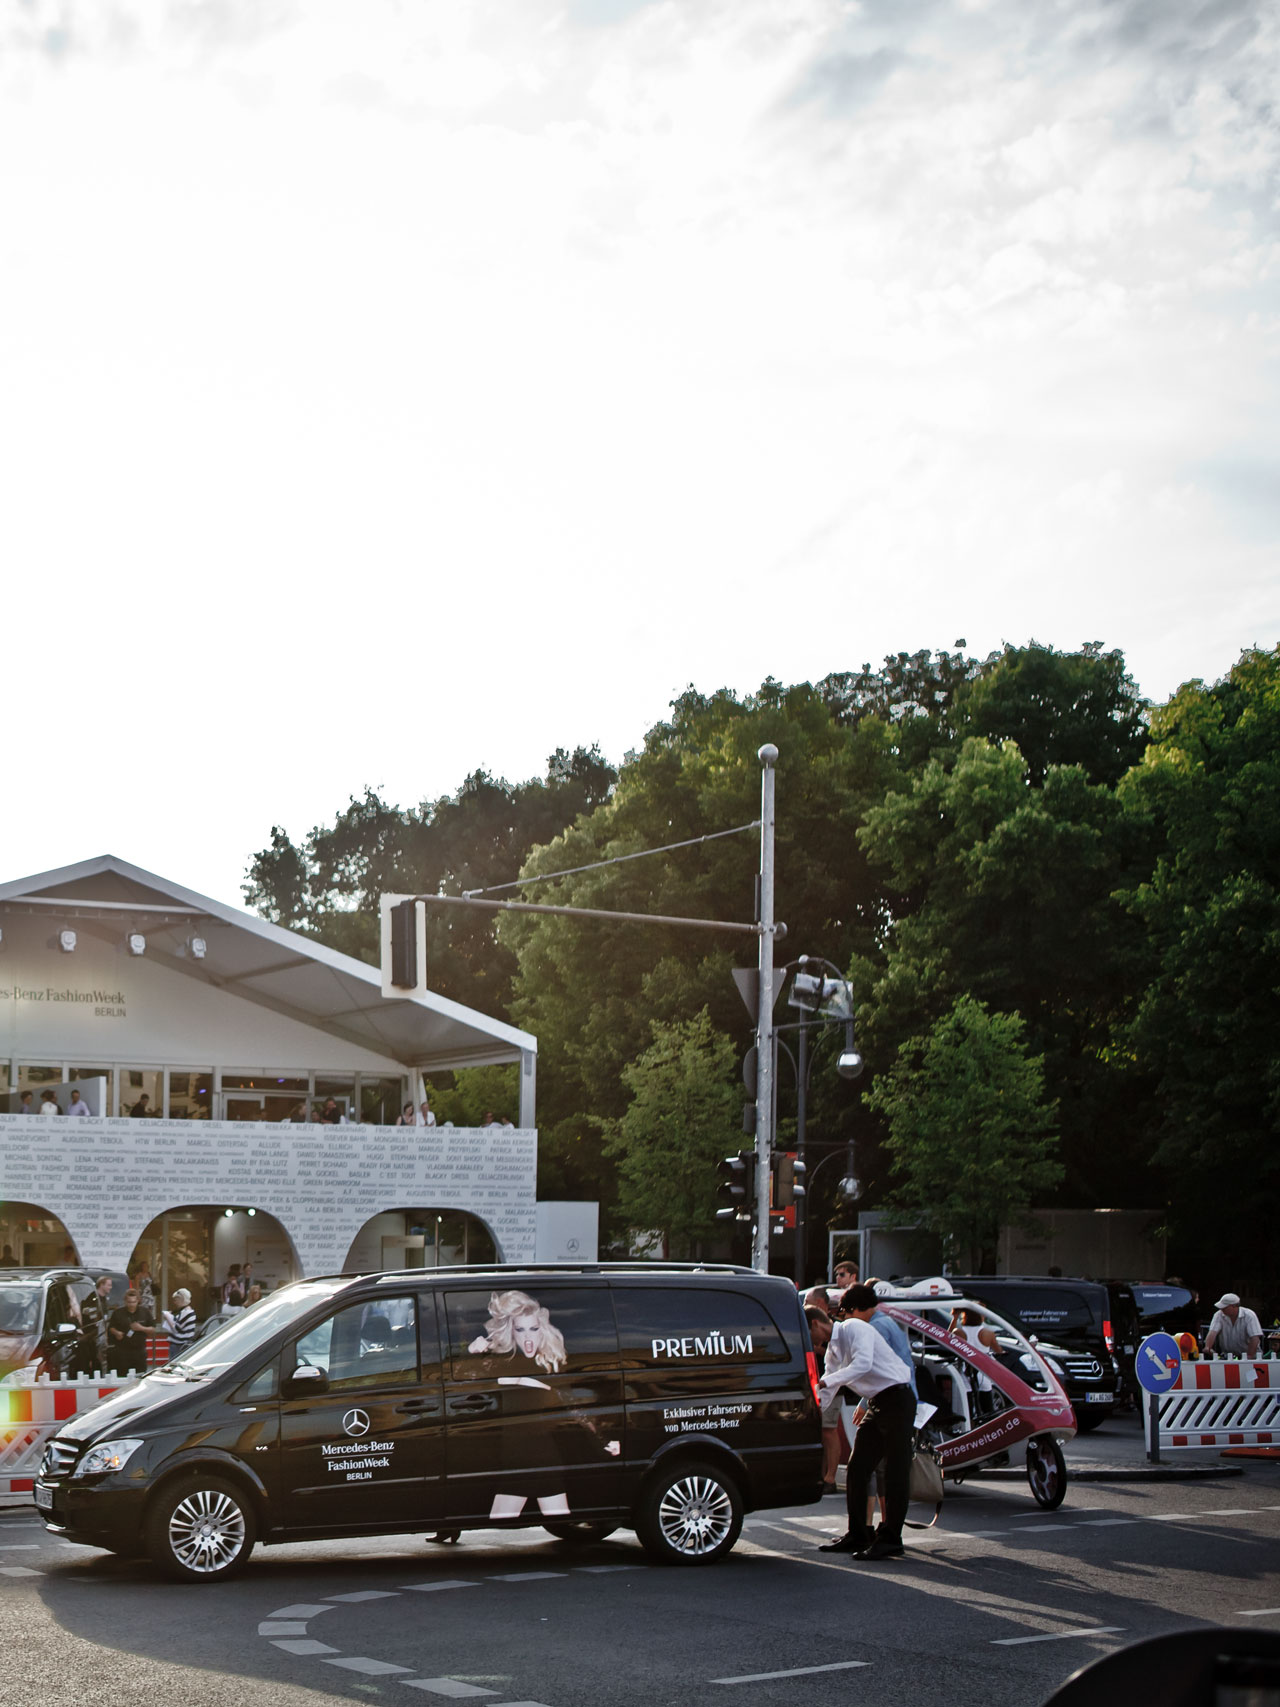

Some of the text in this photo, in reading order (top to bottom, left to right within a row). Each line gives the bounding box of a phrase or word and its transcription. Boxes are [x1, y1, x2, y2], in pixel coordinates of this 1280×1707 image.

[46, 988, 125, 1004] FashionWeek
[95, 1007, 126, 1017] BERLIN
[912, 1318, 977, 1358] East Side Gallery
[651, 1334, 753, 1358] PREMIUM
[663, 1403, 752, 1419] Exklusiver Fahrservice
[664, 1418, 739, 1432] von Mercedes-Benz
[321, 1441, 395, 1455] Mercedes-Benz
[328, 1456, 390, 1471] FashionWeek
[346, 1472, 372, 1481] BERLIN
